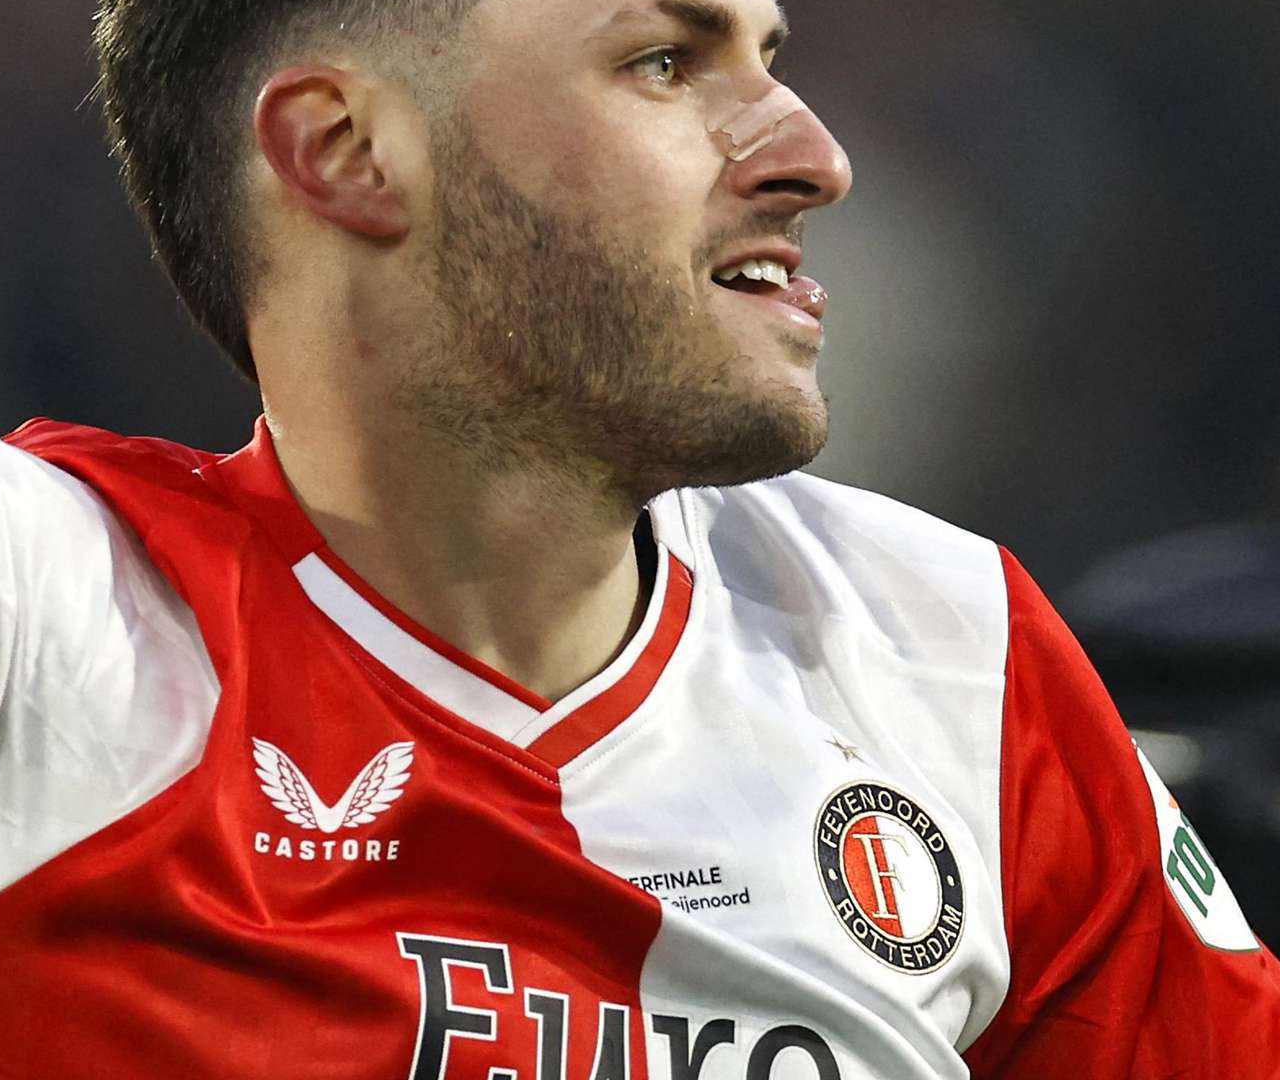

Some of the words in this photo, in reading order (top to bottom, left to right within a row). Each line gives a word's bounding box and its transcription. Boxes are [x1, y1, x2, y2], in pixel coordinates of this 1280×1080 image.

[254, 831, 401, 861] CASTORE
[819, 787, 945, 853] FEYENOORD
[624, 866, 723, 892] ERFINALE
[852, 833, 910, 920] F
[1166, 812, 1217, 919] TO
[661, 886, 751, 914] eijenoord
[836, 903, 963, 969] ROTTERDAM
